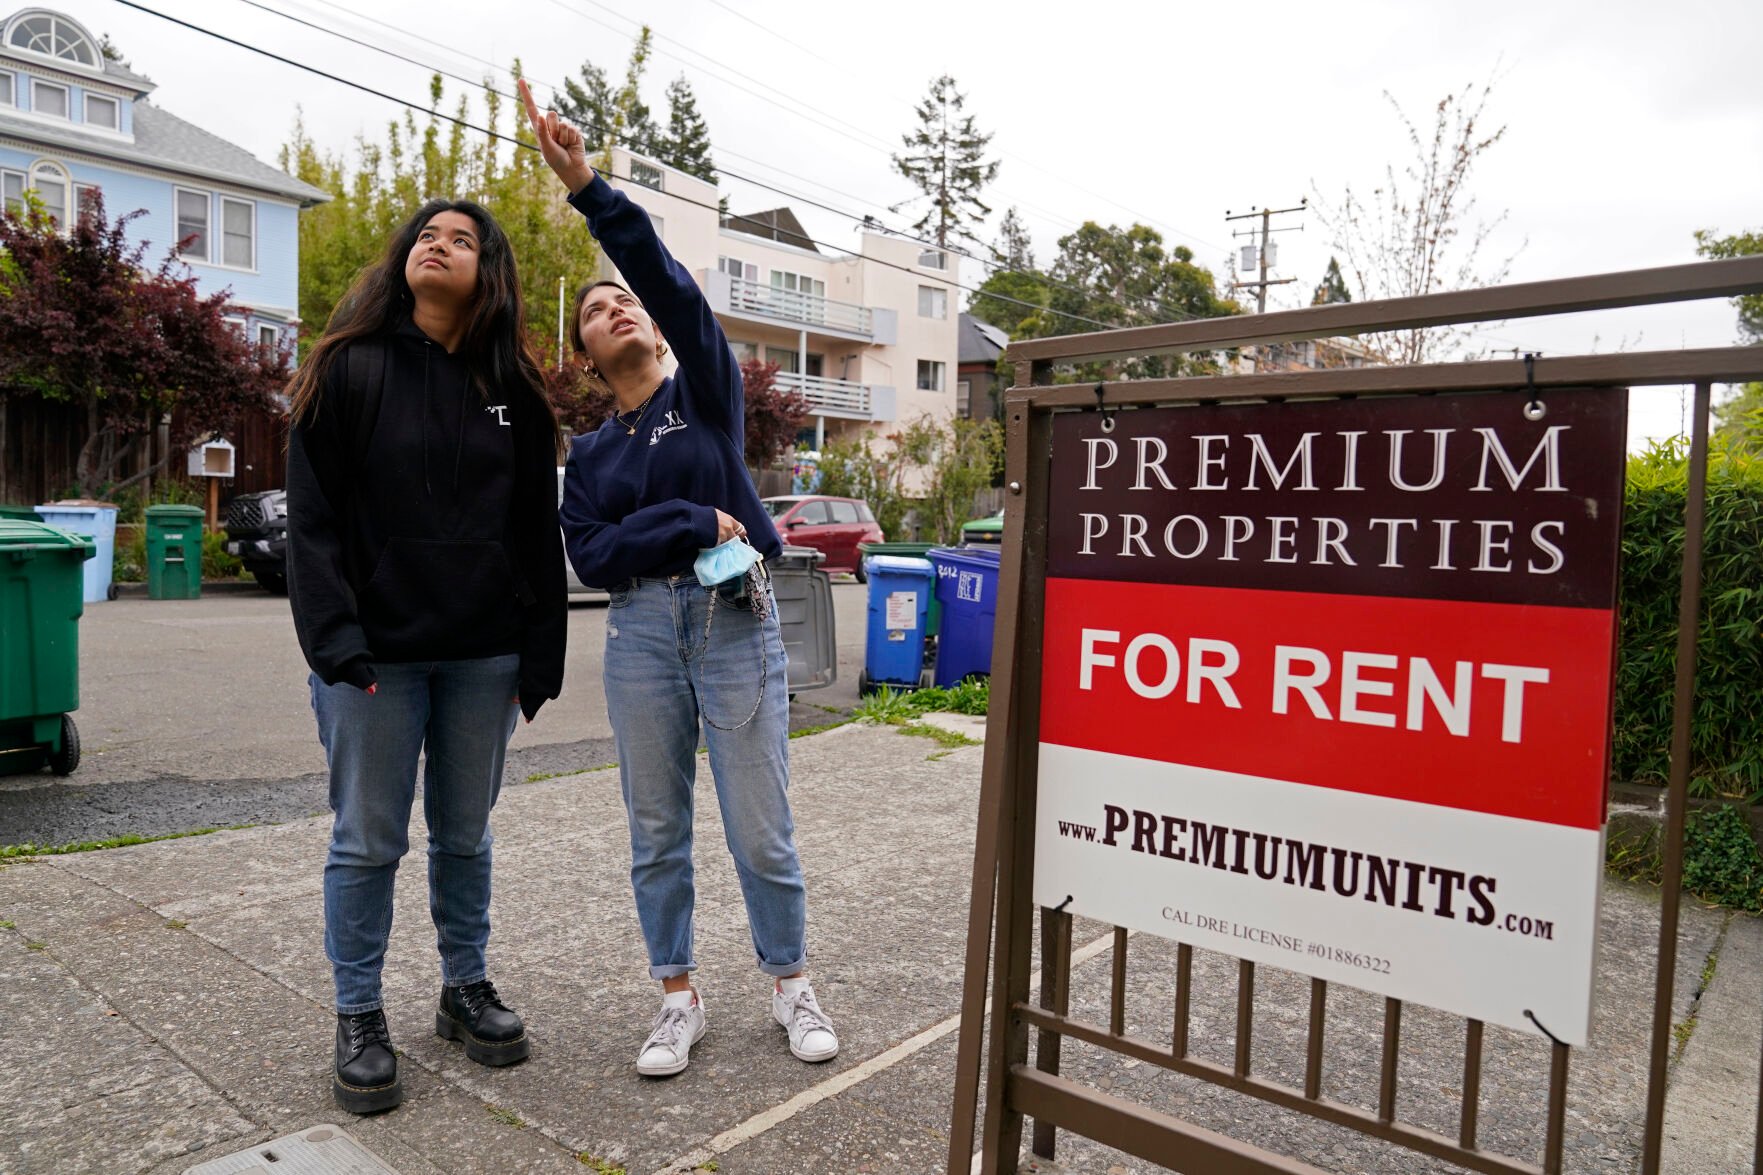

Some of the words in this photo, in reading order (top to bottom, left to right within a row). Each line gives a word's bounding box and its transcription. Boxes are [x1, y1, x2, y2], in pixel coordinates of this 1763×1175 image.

[1079, 425, 1571, 492] PREMIUM
[1077, 513, 1565, 575] PROPERTIES
[1079, 628, 1242, 709] FOR
[1272, 645, 1550, 744] RENT
[1162, 906, 1193, 925] CAL
[1197, 914, 1229, 934] DRE
[1233, 923, 1303, 953] LICENSE
[1307, 942, 1391, 974] #01886322
